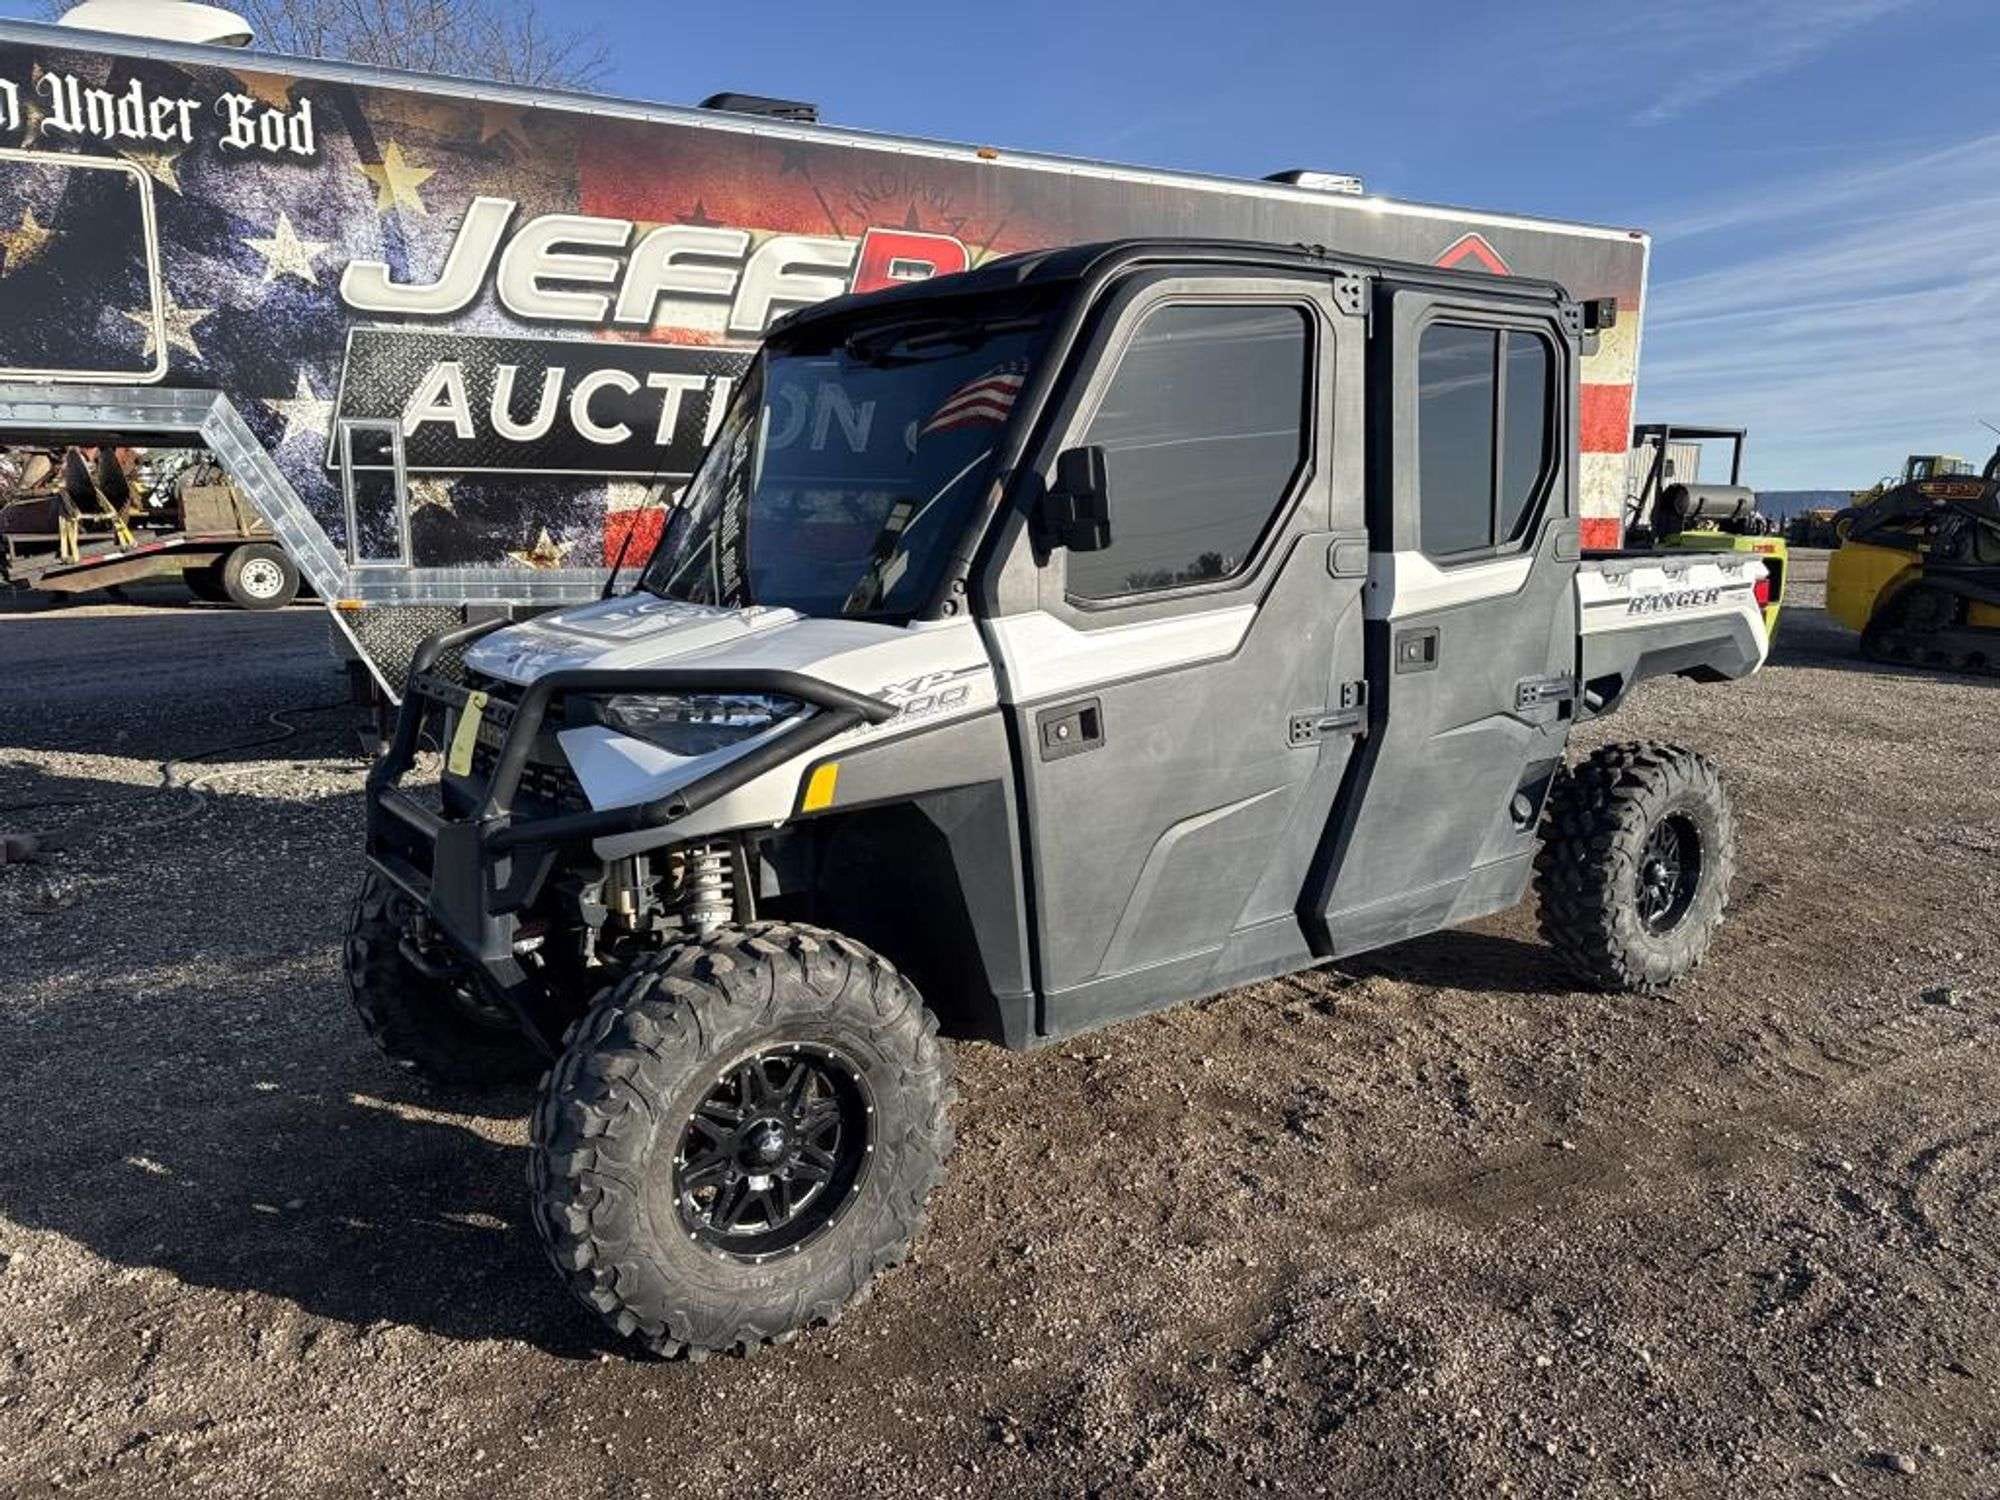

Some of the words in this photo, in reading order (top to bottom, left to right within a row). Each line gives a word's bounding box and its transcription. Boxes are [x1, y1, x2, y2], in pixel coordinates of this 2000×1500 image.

[36, 72, 201, 144] Under
[214, 91, 316, 156] God
[1627, 587, 1721, 615] RANGER
[882, 670, 956, 701] XP
